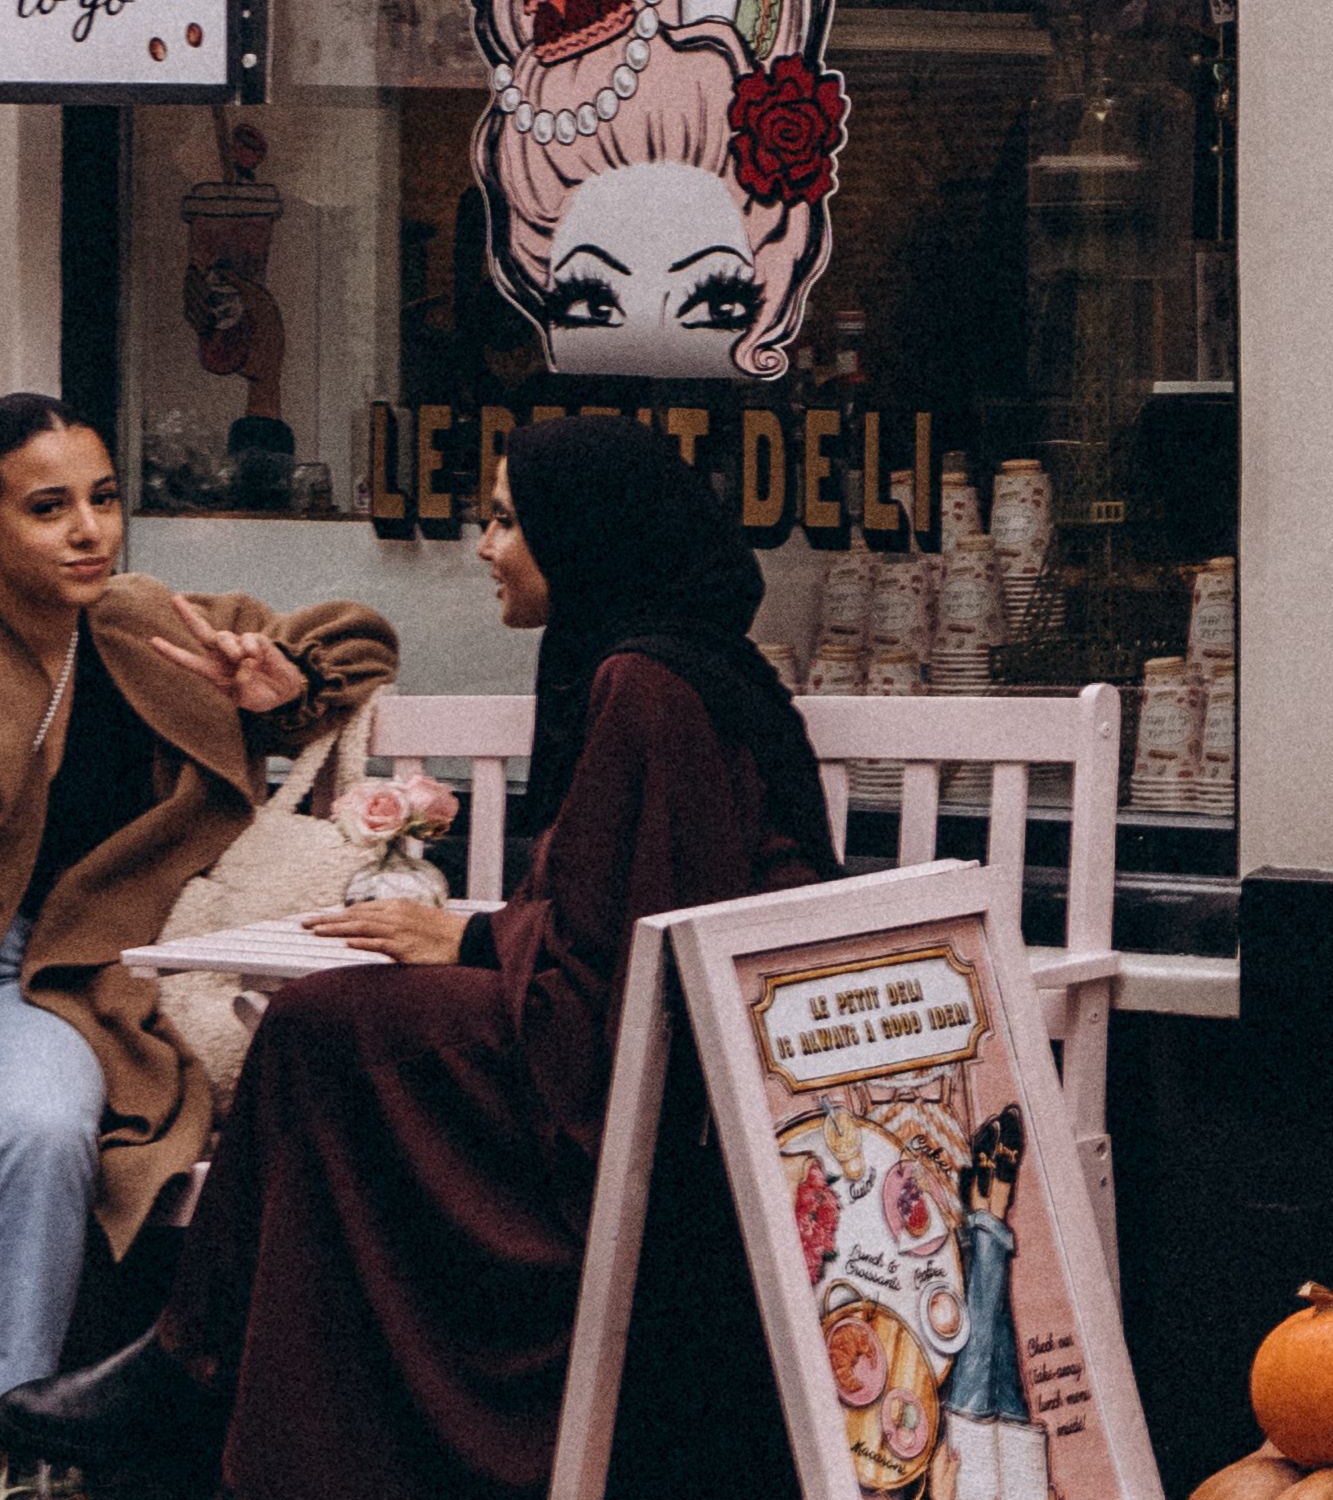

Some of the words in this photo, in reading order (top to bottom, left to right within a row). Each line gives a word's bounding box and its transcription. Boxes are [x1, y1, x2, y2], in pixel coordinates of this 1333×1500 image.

[371, 402, 456, 526] LE
[742, 408, 935, 536] DELI
[799, 1021, 861, 1056] ALWAYS
[863, 1018, 877, 1043] A
[879, 1009, 923, 1041] GOOD
[809, 994, 831, 1021] LE
[834, 985, 882, 1016] PETIT
[885, 978, 925, 1007] DELI
